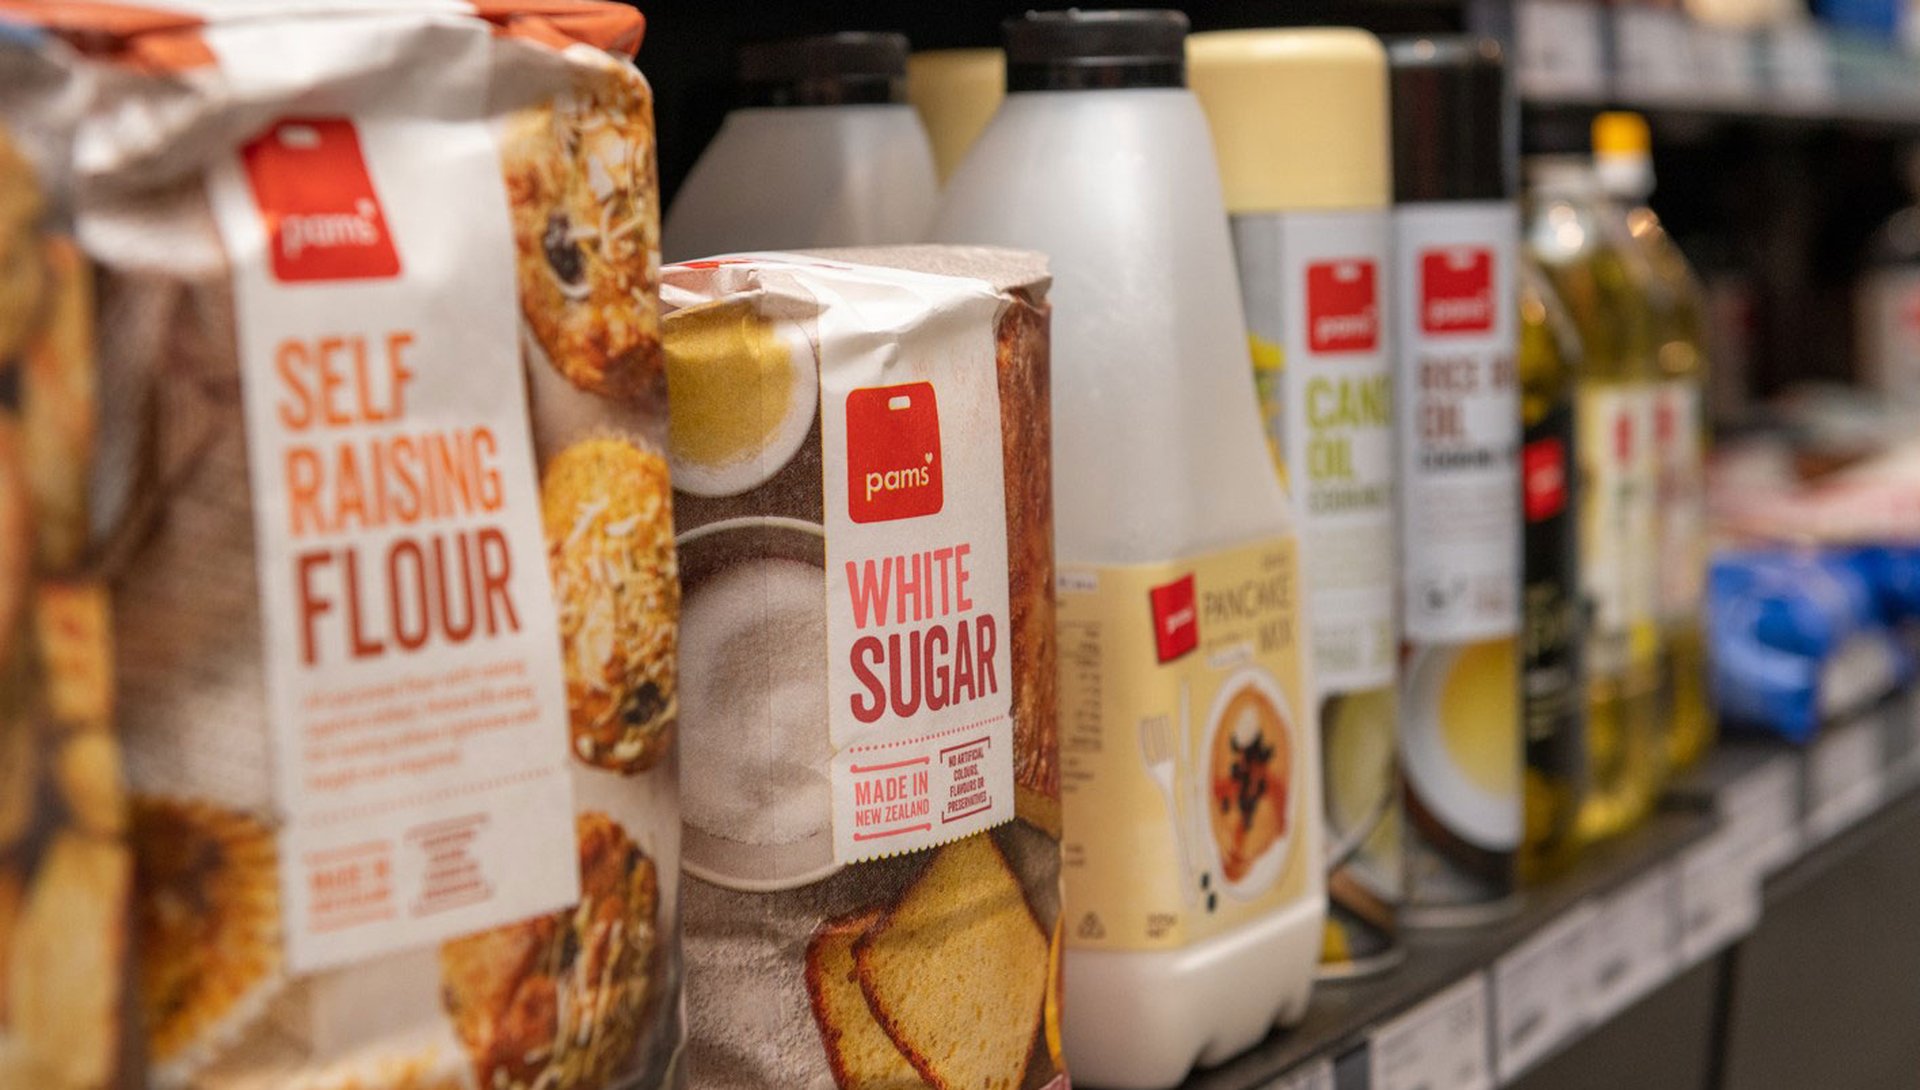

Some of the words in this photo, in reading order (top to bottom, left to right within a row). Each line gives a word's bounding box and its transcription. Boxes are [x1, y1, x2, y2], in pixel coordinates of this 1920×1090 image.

[281, 211, 379, 257] pams
[274, 331, 416, 432] SELF
[285, 425, 506, 539] RAISING
[866, 464, 930, 502] pams
[294, 527, 522, 667] FLOUR
[845, 543, 973, 630] WHITE
[850, 614, 998, 724] SUGAR
[948, 754, 956, 768] NO
[958, 747, 984, 766] ARTIFICIAL
[854, 775, 908, 806] MADE
[913, 770, 929, 797] IN
[947, 790, 987, 814] PRESERVATIVES
[950, 779, 977, 798] FLAVOURS
[977, 776, 985, 789] OR
[855, 807, 883, 828] NEW
[885, 798, 930, 823] ZEALAND
